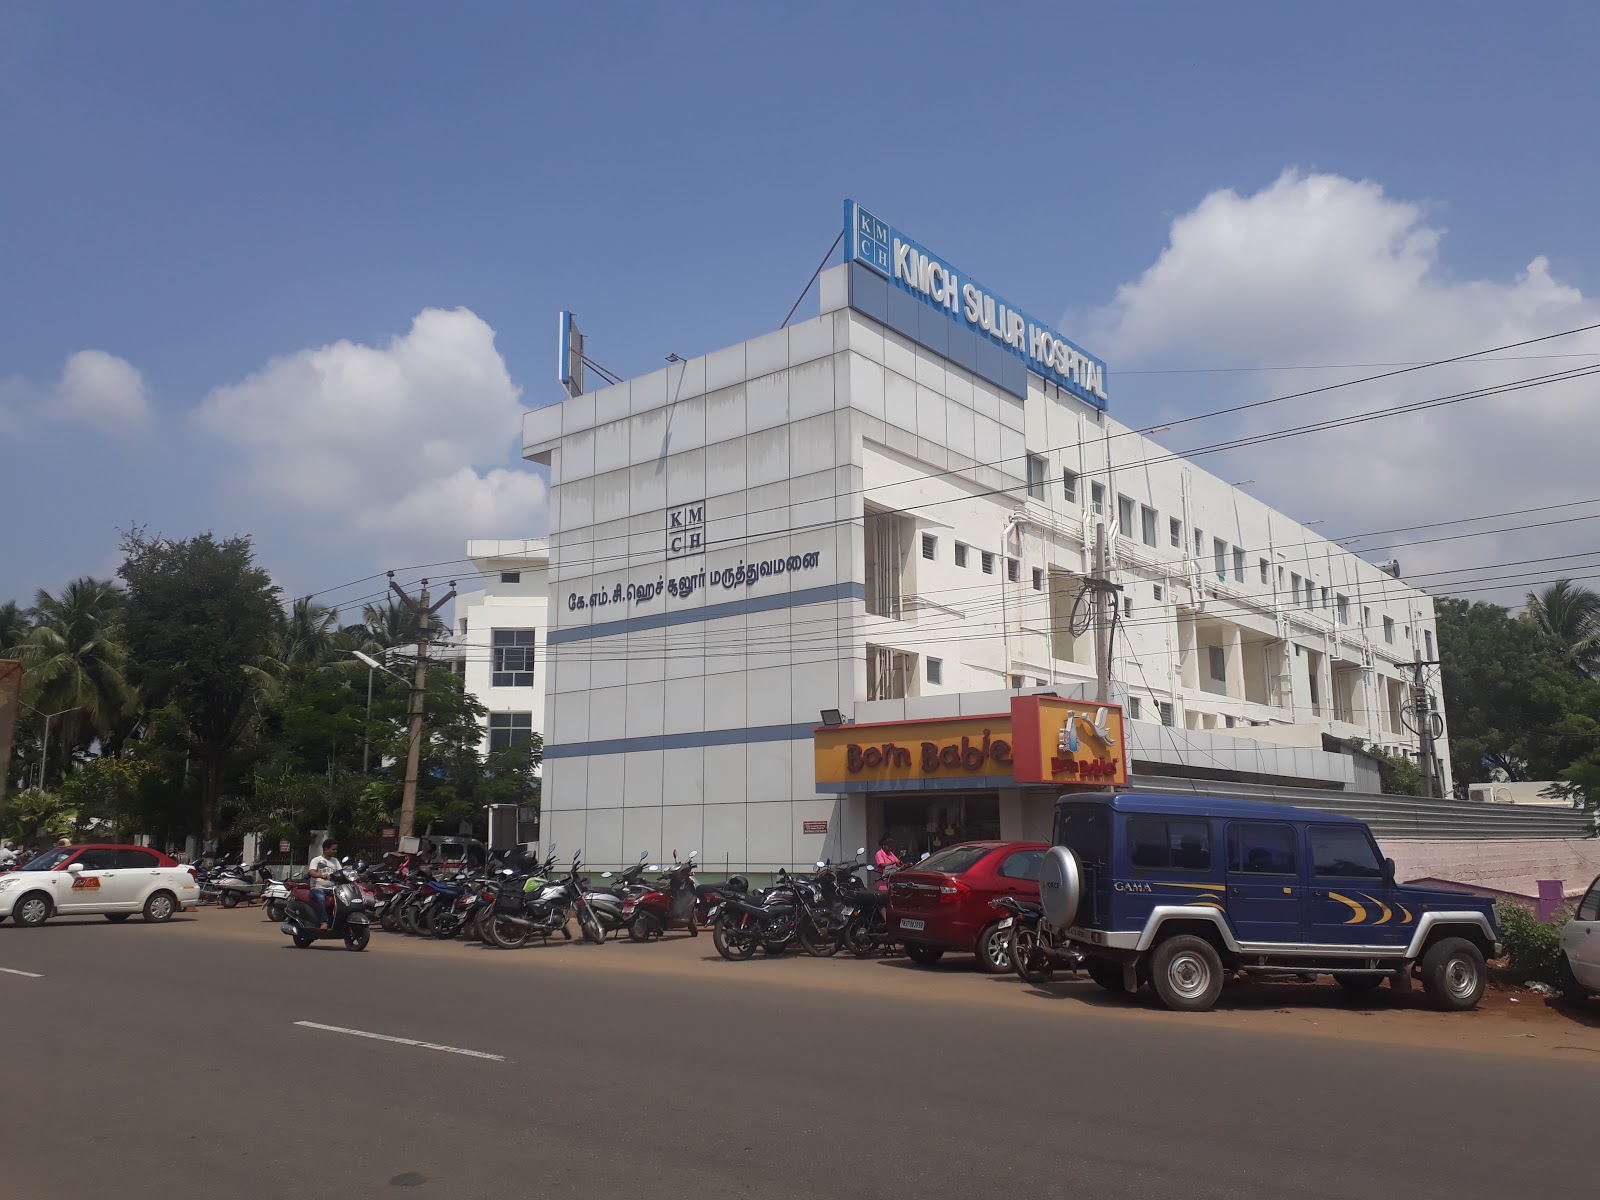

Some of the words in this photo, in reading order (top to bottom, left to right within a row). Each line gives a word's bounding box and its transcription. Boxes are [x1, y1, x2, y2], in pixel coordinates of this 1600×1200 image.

[894, 238, 959, 314] KMCH
[963, 283, 1025, 353] SULUR
[1028, 323, 1107, 400] HOSPITAL
[710, 551, 820, 589] மருத்துவமனை
[847, 743, 912, 773] Born
[921, 728, 1013, 773] Babie
[1114, 881, 1152, 892] GAMA
